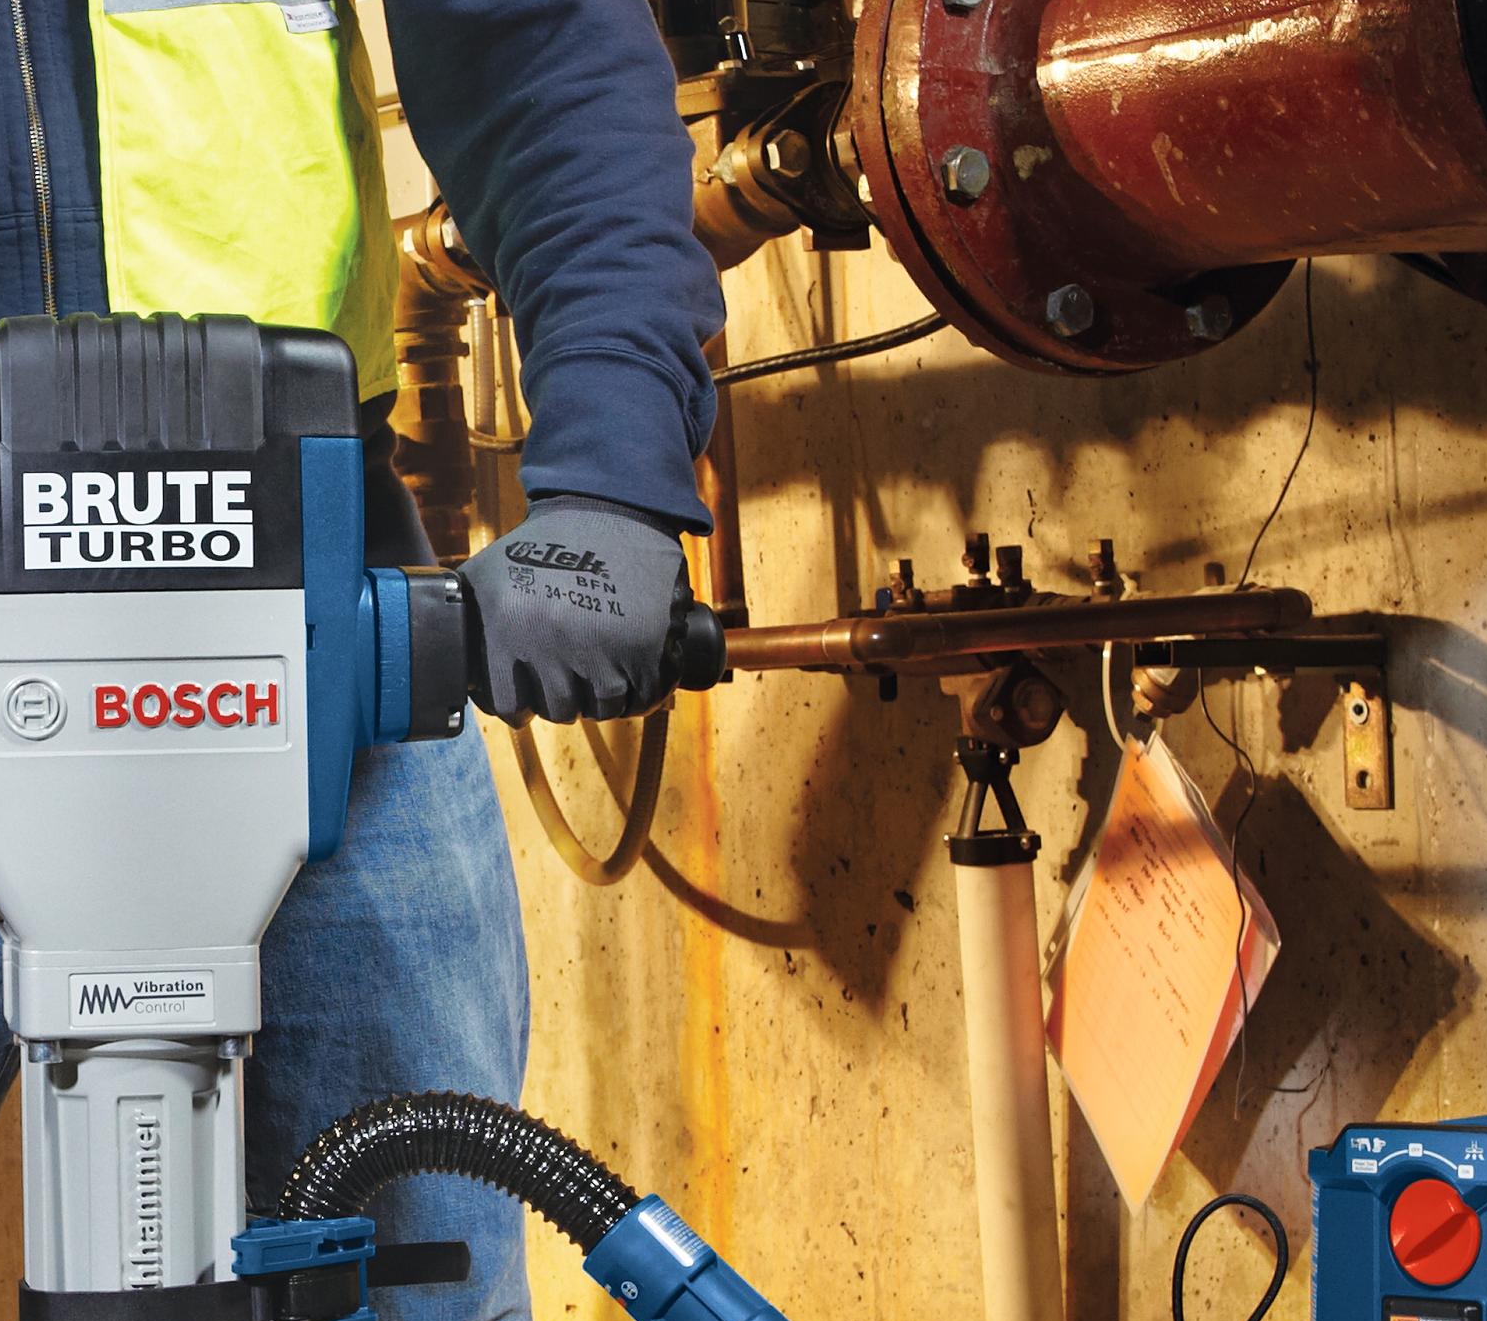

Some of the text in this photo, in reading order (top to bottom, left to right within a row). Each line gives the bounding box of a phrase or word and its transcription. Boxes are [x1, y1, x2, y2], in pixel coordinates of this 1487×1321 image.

[22, 470, 254, 526] BRUTE
[38, 529, 241, 563] TURBO
[544, 584, 625, 617] 34-C232 XL
[576, 575, 617, 595] BFN
[94, 681, 279, 728] BOSCH
[133, 979, 204, 993] Vibration
[134, 1000, 186, 1014] Control
